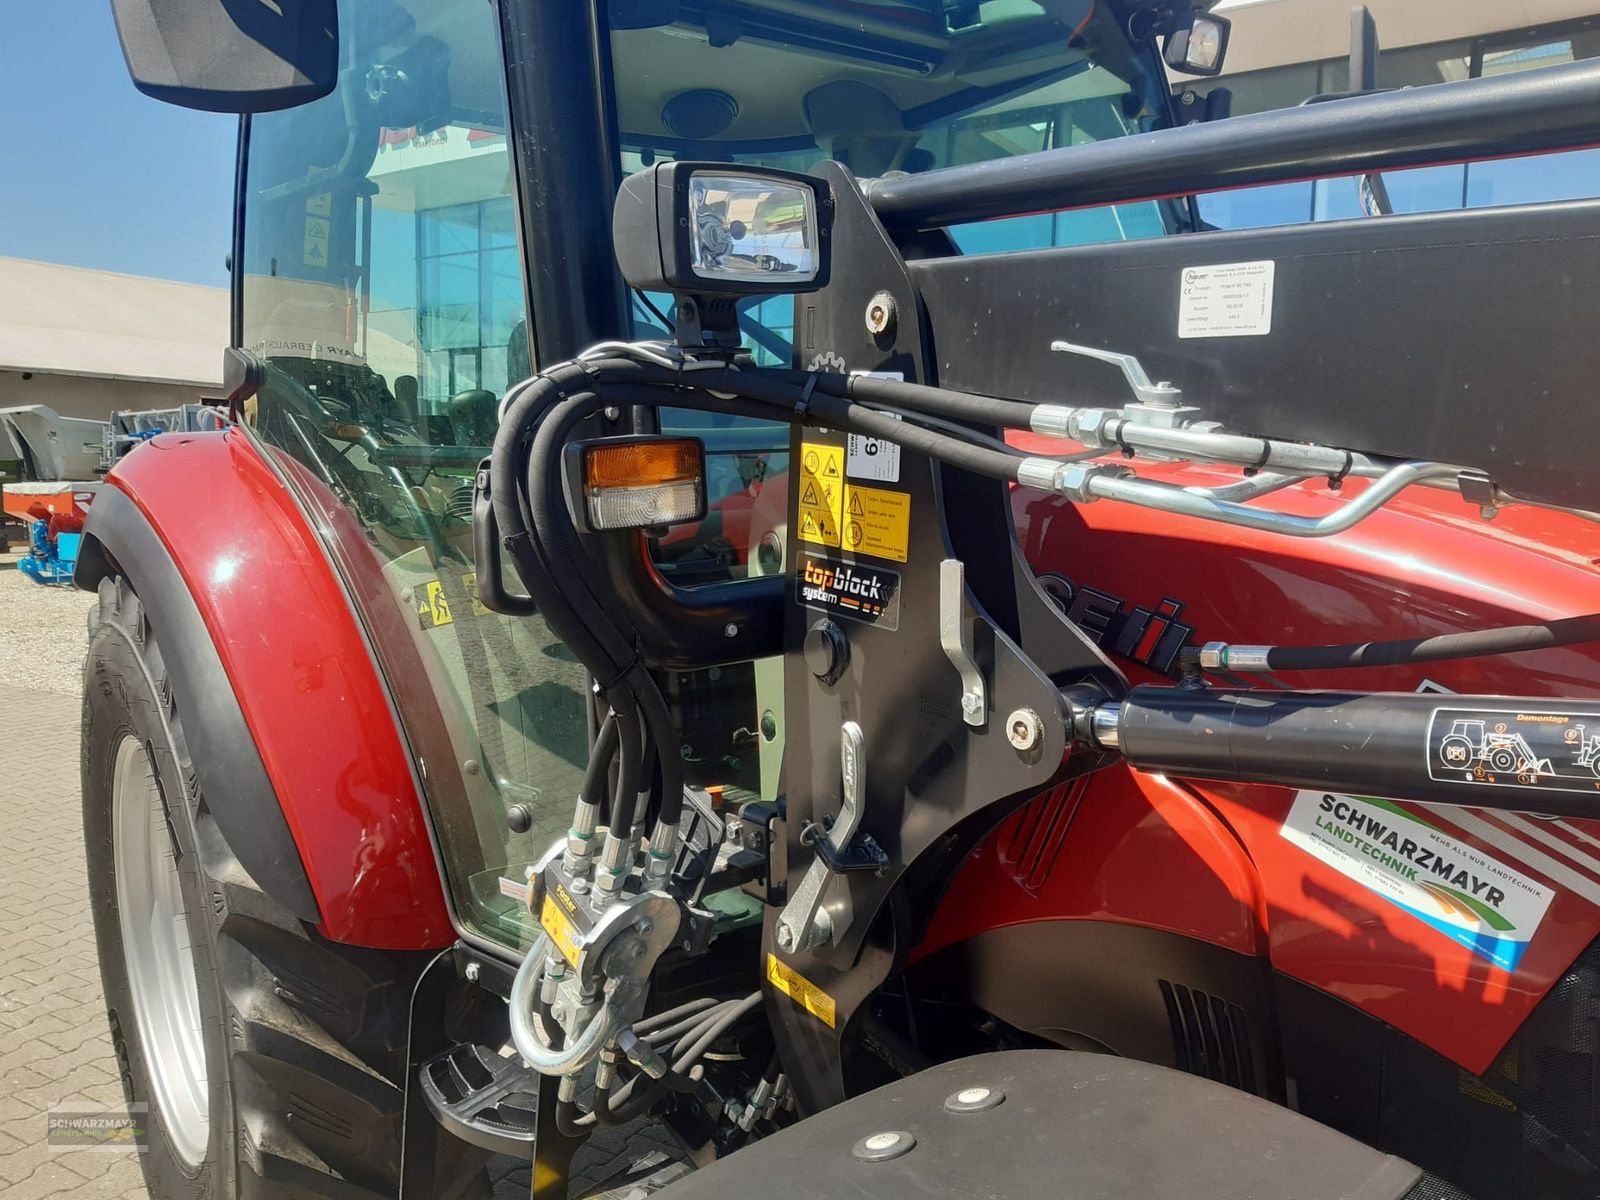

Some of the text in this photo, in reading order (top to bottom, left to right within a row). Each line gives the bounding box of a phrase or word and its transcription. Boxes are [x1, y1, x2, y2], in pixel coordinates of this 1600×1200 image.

[802, 586, 838, 605] system
[804, 560, 881, 600] topblock
[1516, 714, 1569, 723] Demontage
[1315, 815, 1419, 881] LANDTECHNIK
[1319, 794, 1505, 908] SCHWARZMAYR
[1429, 833, 1543, 899] MEHR ALS NUR LANDTECHNIK.
